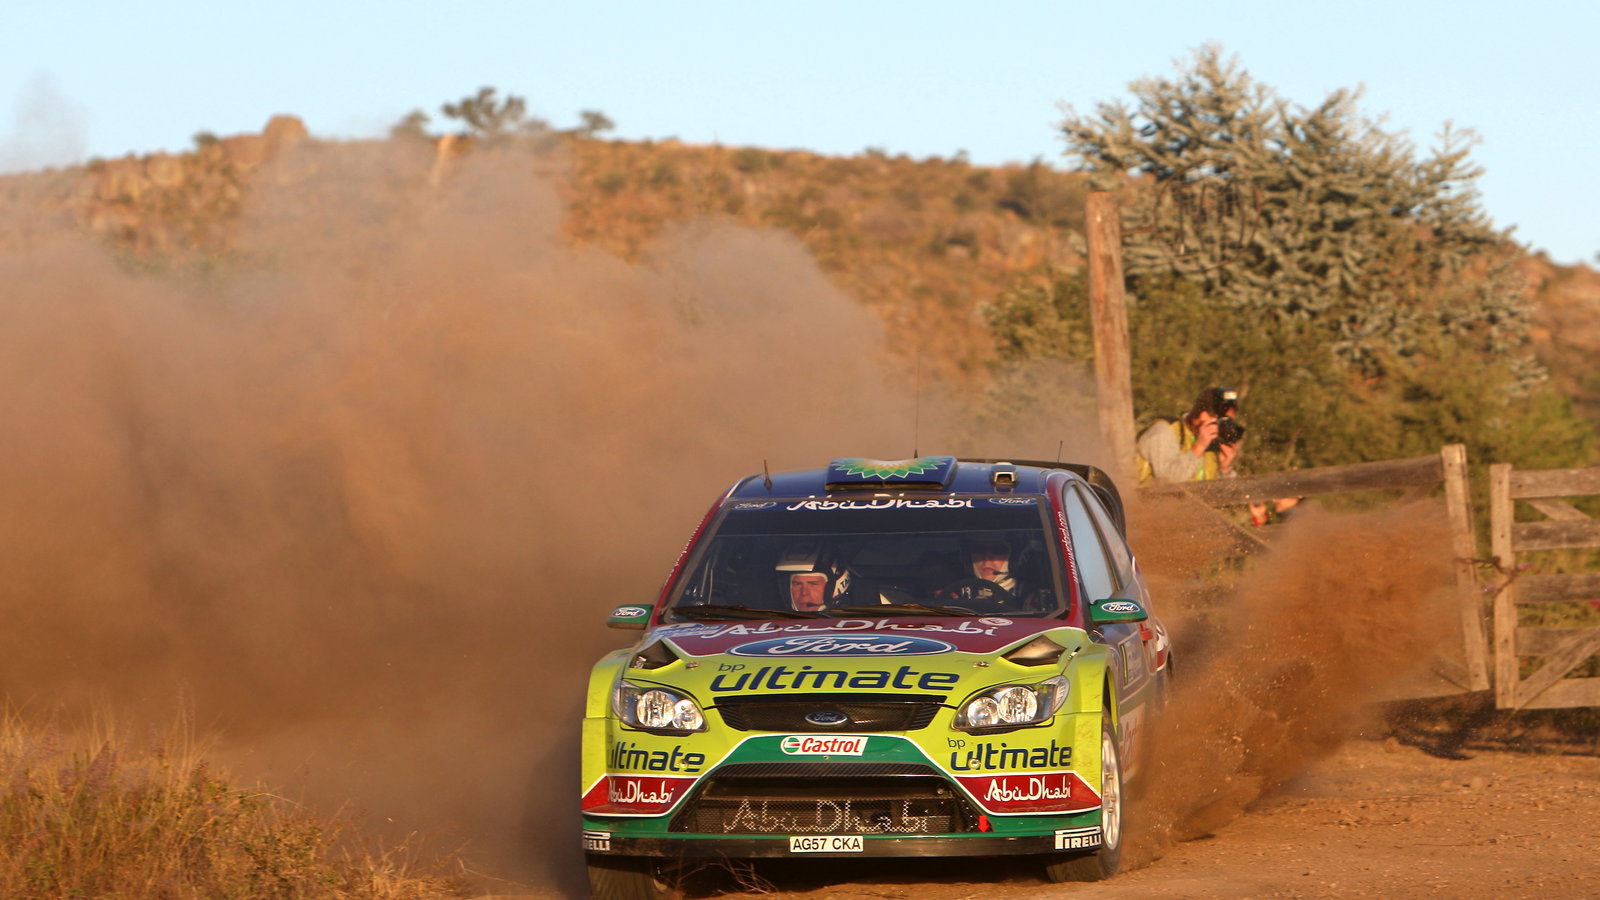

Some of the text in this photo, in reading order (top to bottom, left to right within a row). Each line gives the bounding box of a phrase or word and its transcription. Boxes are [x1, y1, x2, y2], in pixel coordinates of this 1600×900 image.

[786, 492, 975, 511] Abu Dhabi
[998, 497, 1033, 505] Ford
[614, 608, 641, 617] Ford
[1108, 602, 1135, 611] Ford
[700, 621, 830, 639] Abu
[828, 618, 998, 637] Dhabi
[767, 635, 910, 655] Ford
[717, 662, 746, 674] bp
[709, 666, 961, 692] ultimate
[801, 737, 862, 753] Castrol
[947, 737, 966, 749] bp
[950, 739, 1073, 771] ultimate
[625, 780, 675, 804] Dhabi
[984, 775, 1072, 802] Abu Dhabi
[722, 797, 929, 834] Abu Dhabi
[792, 837, 861, 851] AG57 CKA
[1055, 826, 1102, 850] PIRELLI
